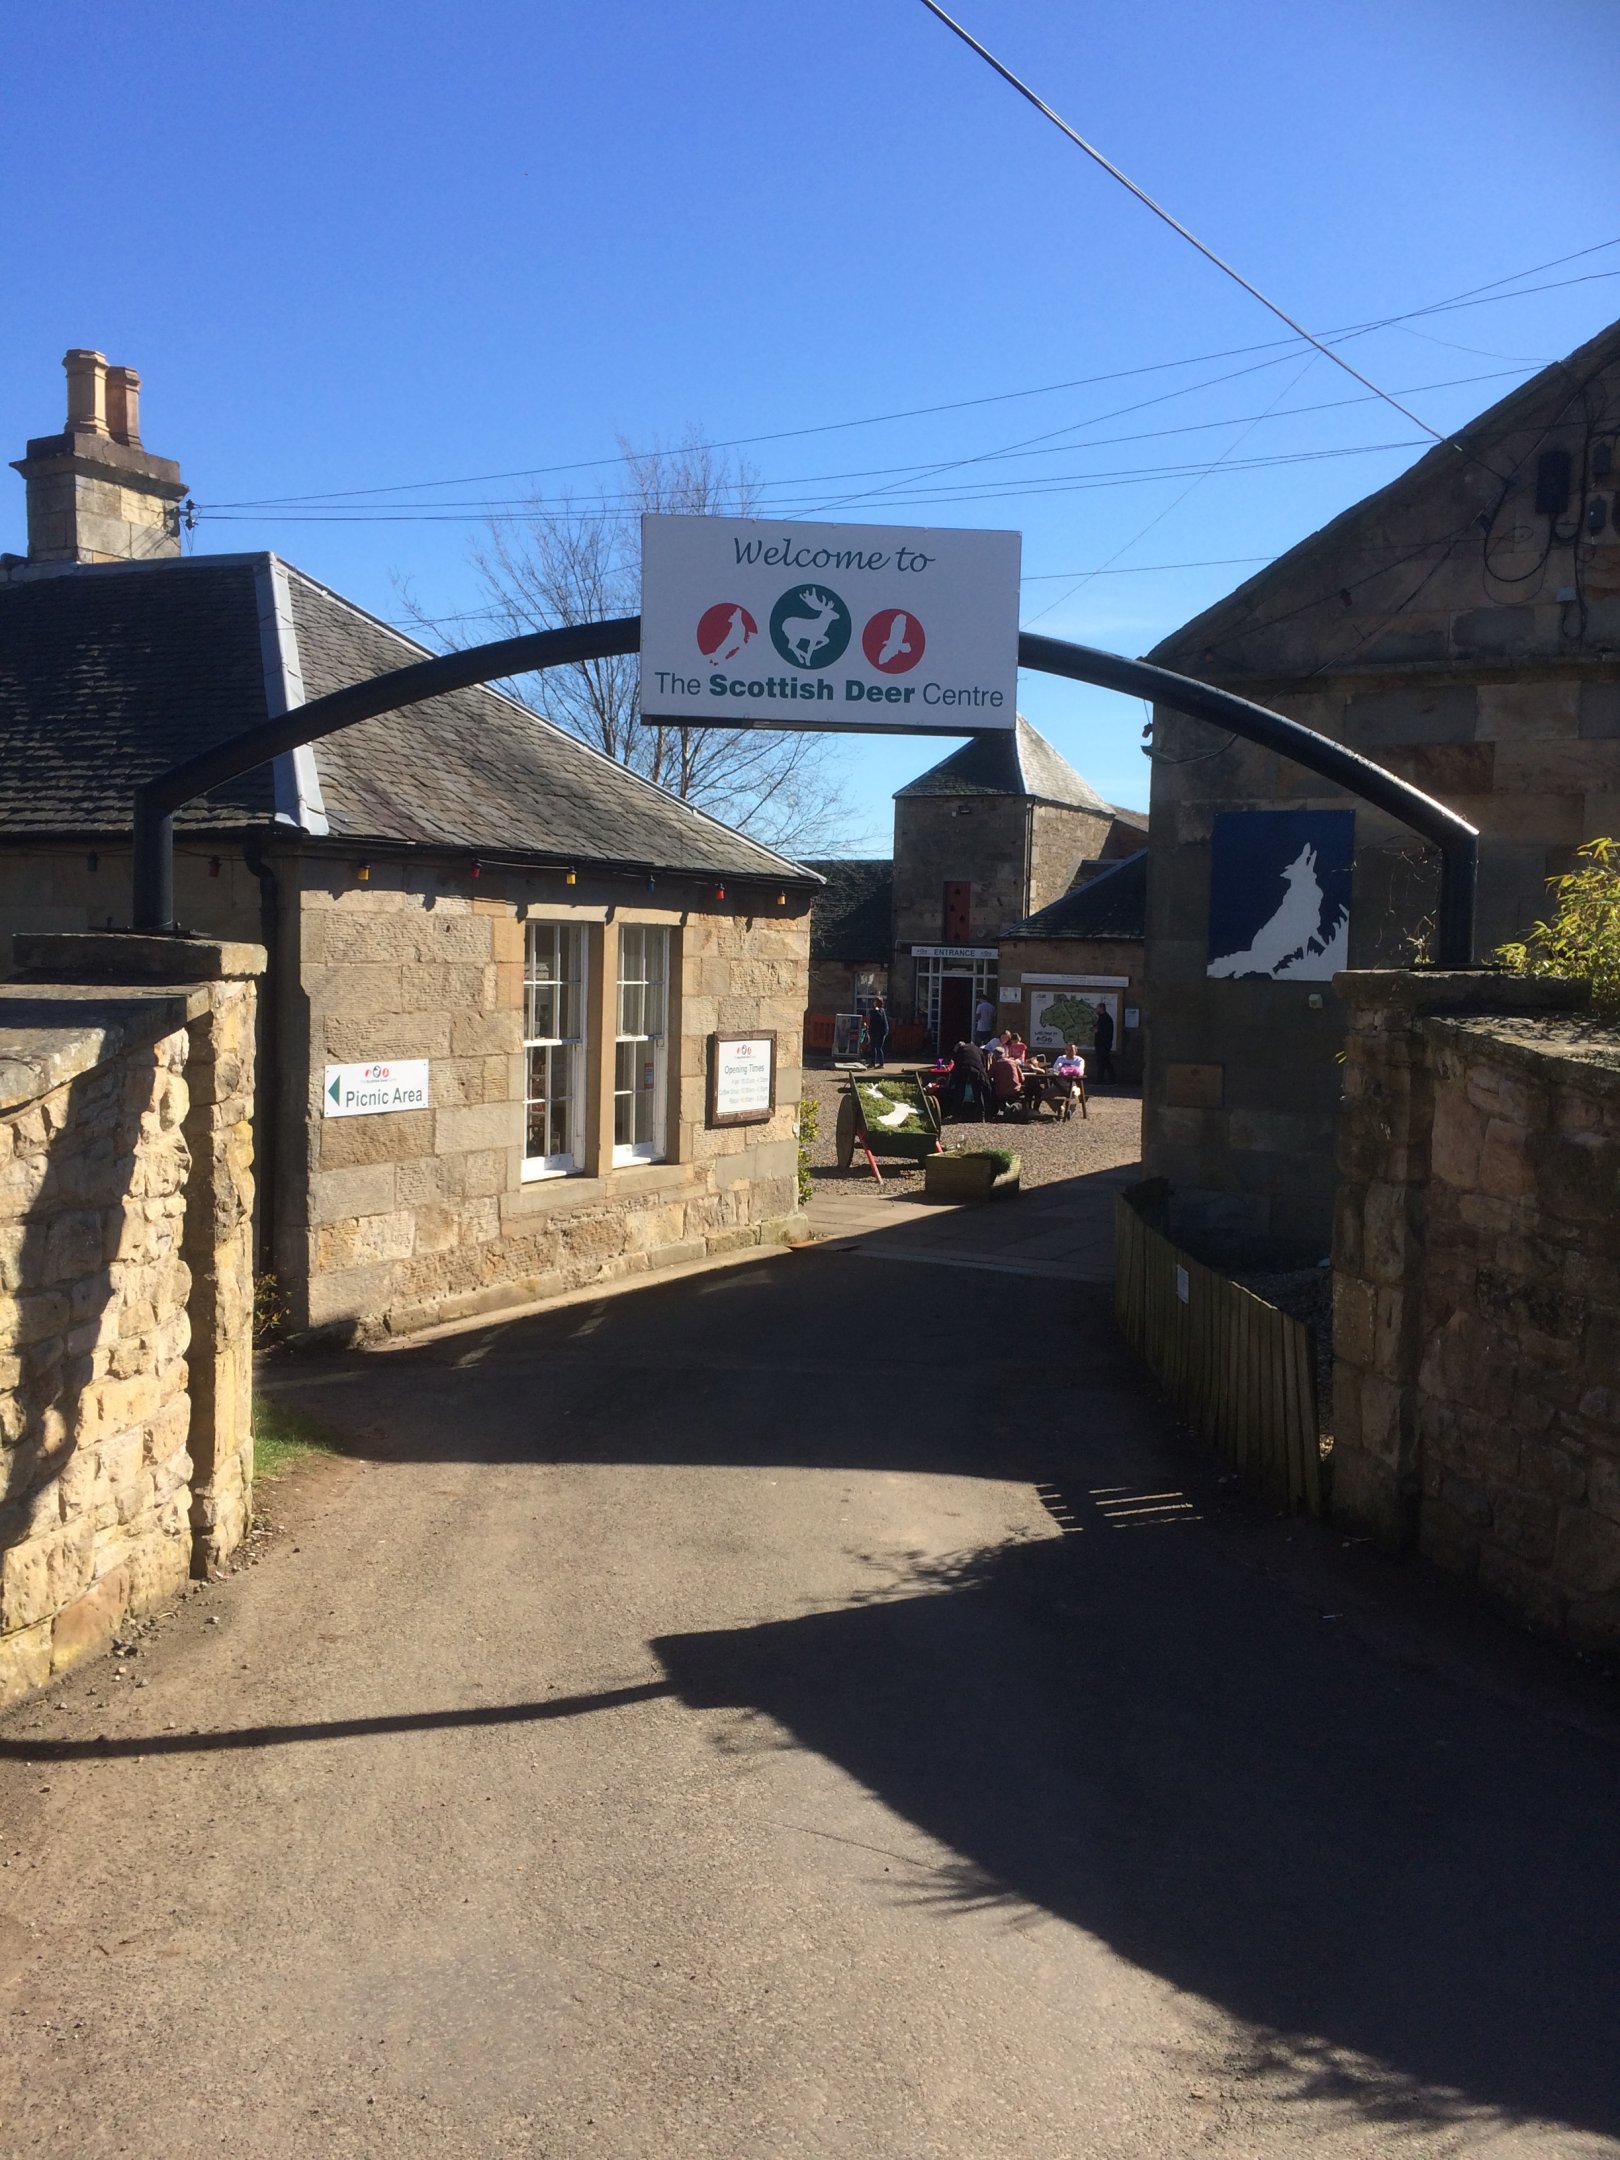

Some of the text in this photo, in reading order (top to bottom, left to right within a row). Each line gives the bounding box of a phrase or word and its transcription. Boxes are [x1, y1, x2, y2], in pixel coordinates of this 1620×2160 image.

[733, 537, 936, 573] Welcome to
[655, 671, 1004, 708] The Scottish Deer Centre
[933, 948, 976, 957] ENTRANCE
[724, 1064, 764, 1076] Opening Times
[346, 1087, 423, 1108] Picnic Area
